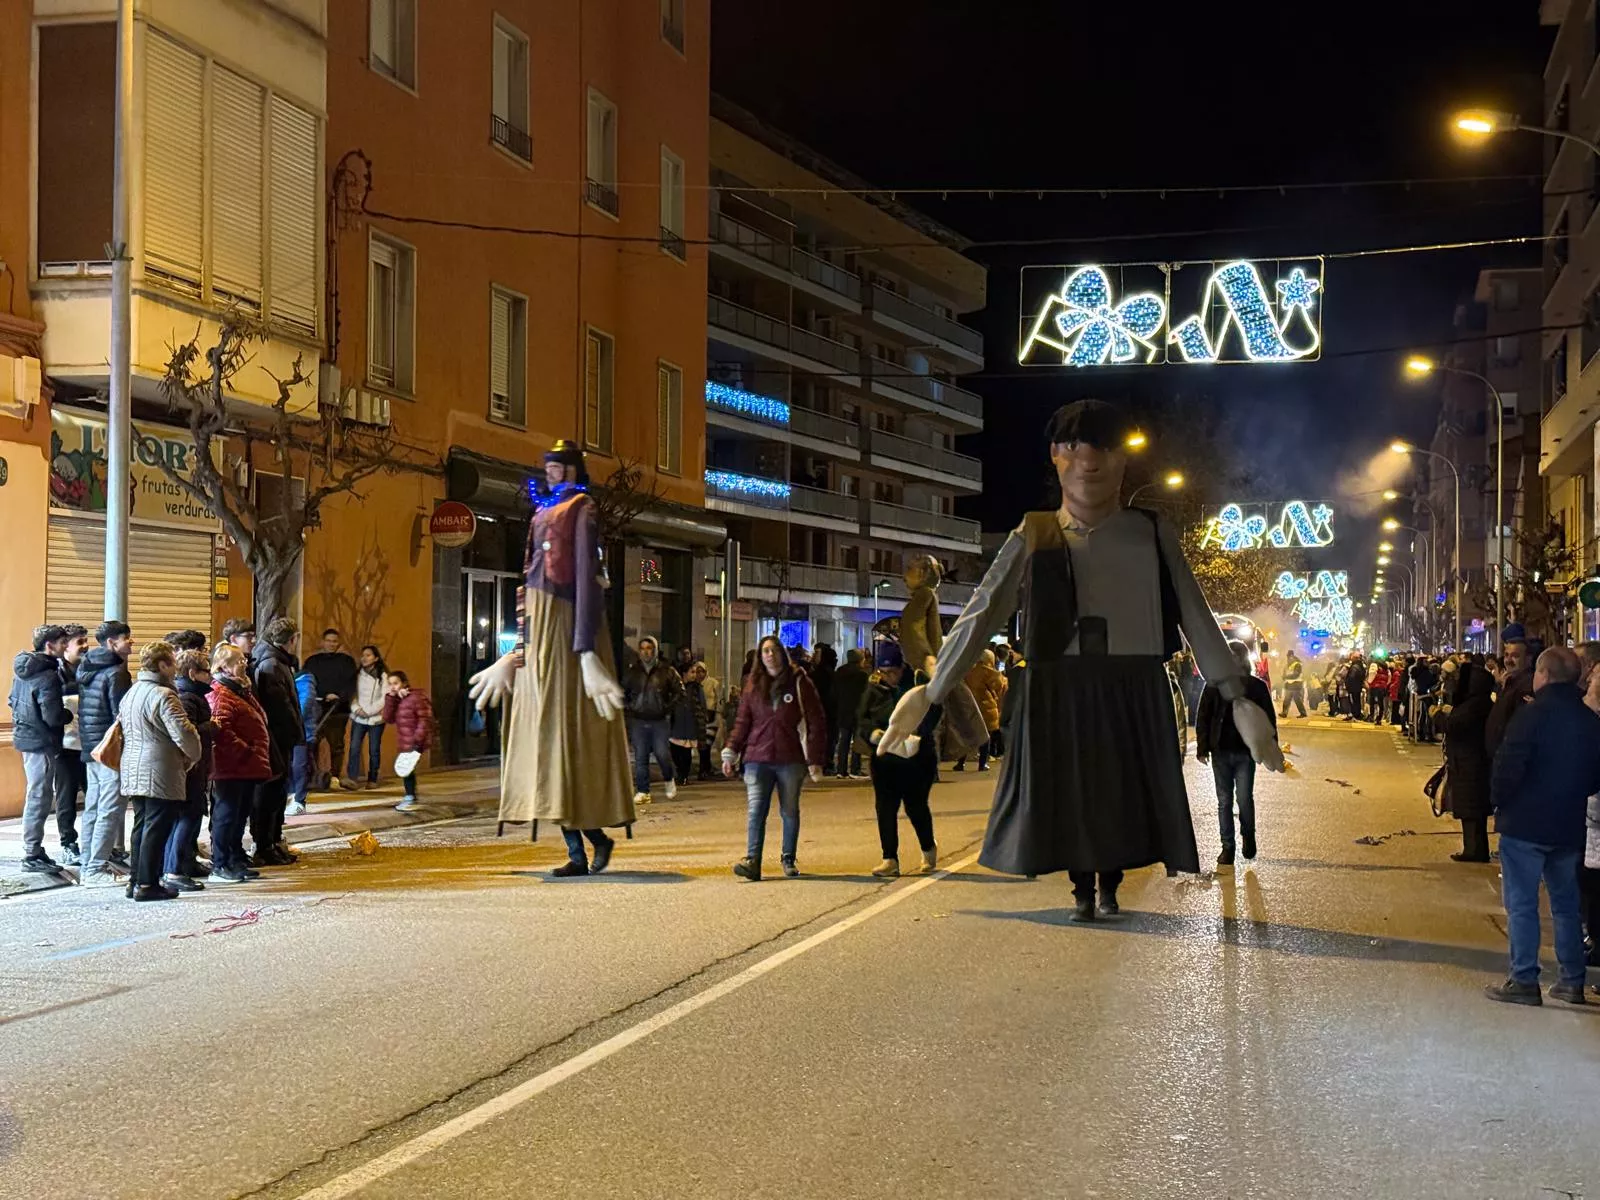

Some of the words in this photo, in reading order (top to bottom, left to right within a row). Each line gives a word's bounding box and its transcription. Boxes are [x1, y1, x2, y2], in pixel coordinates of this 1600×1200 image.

[142, 475, 181, 496] frutas
[165, 501, 217, 519] verduras
[433, 515, 469, 526] AMBAR
